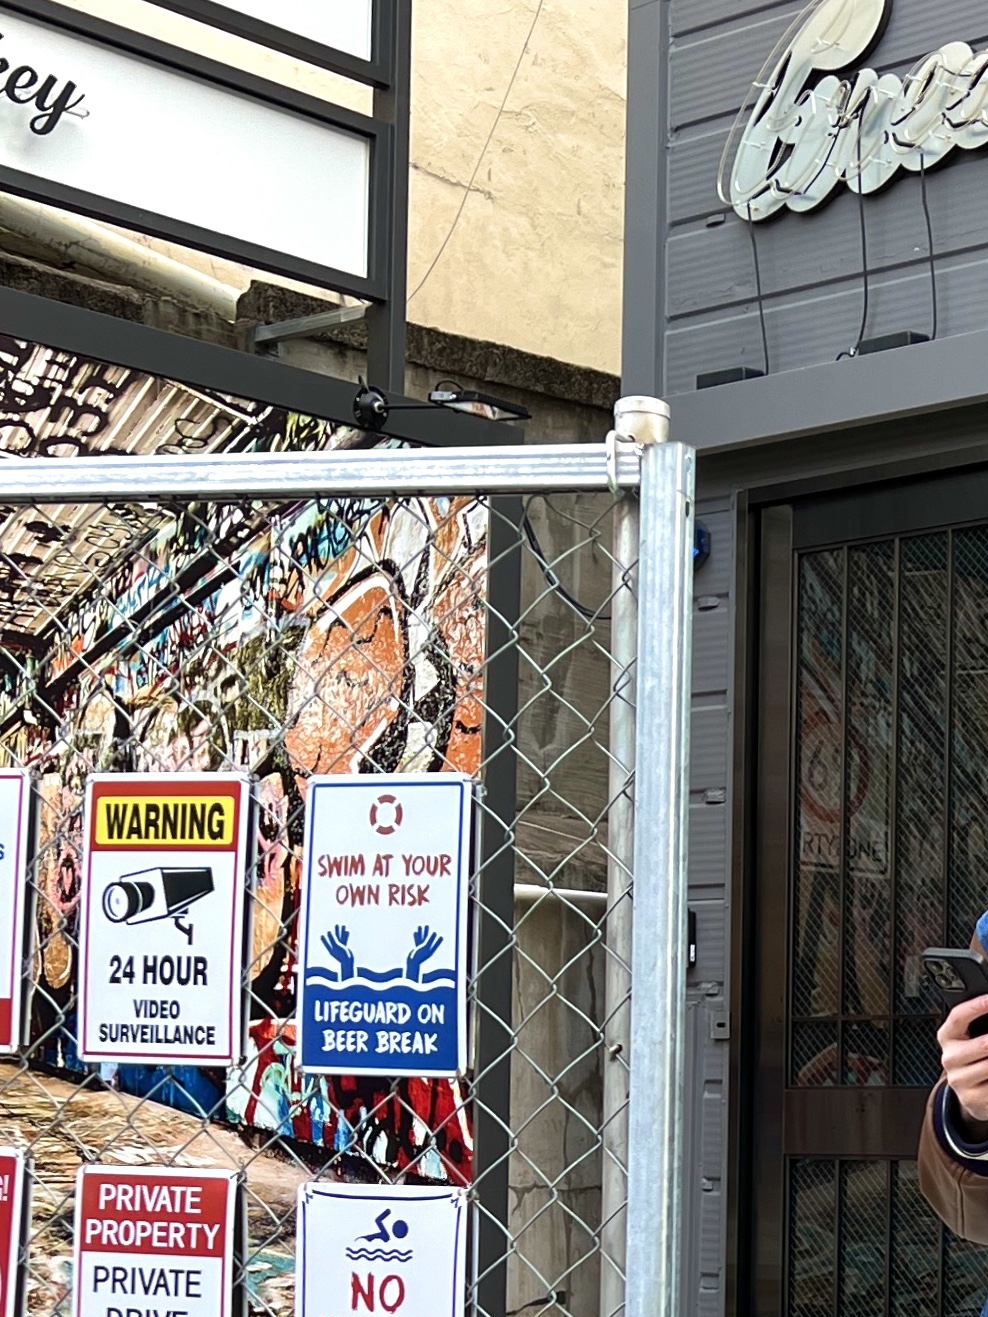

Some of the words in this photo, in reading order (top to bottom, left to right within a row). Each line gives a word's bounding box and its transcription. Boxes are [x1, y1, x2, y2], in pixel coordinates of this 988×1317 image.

[106, 802, 225, 841] WARNING
[318, 854, 365, 878] SWIM
[372, 855, 394, 876] AT
[401, 855, 452, 876] YOUR
[336, 885, 383, 907] OWN
[389, 884, 430, 906] RISK
[109, 955, 135, 985] 24
[142, 956, 208, 986] HOUR
[133, 999, 180, 1019] VIDEO
[315, 1000, 411, 1024] LIFEGUARD
[418, 1004, 444, 1024] ON
[99, 1023, 216, 1046] SURVEILLANCE
[321, 1029, 369, 1053] BEER
[375, 1032, 438, 1055] BREAK
[99, 1184, 202, 1215] PRIVATE
[85, 1219, 221, 1250] PROPERTY
[93, 1266, 202, 1298] PRIVATE
[351, 1271, 405, 1312] NO
